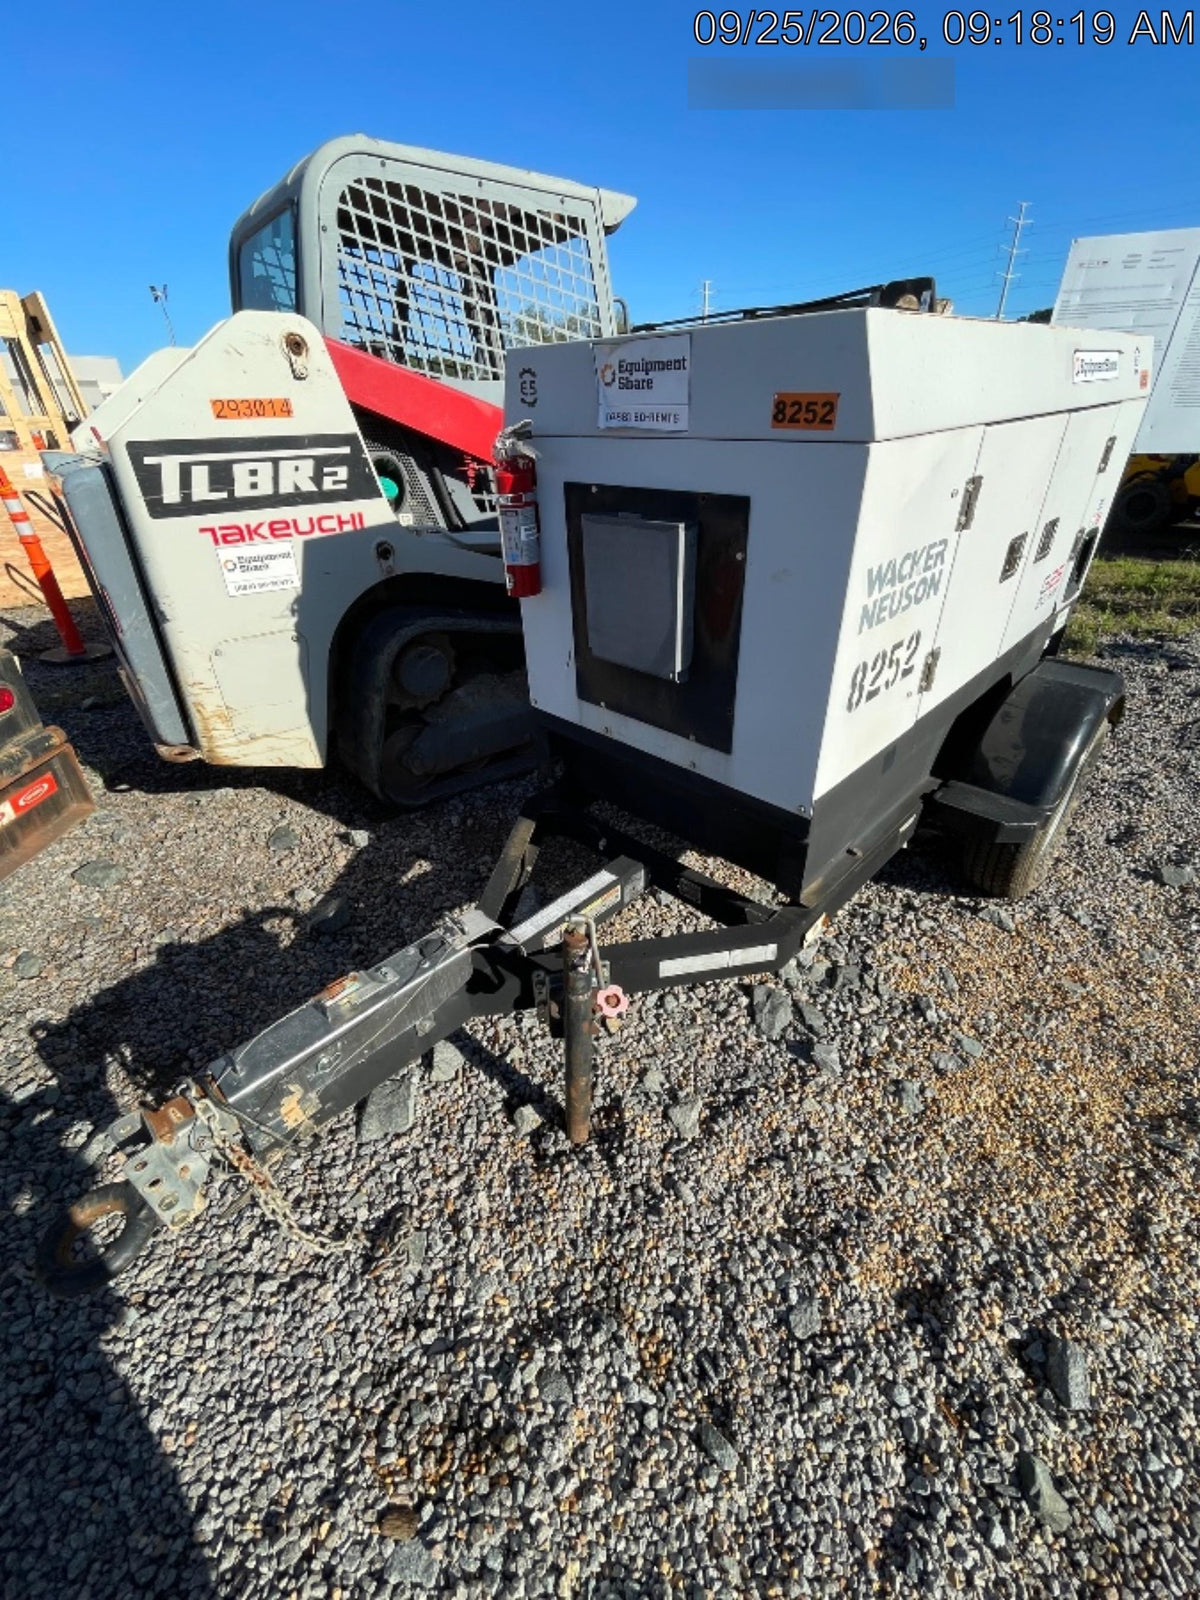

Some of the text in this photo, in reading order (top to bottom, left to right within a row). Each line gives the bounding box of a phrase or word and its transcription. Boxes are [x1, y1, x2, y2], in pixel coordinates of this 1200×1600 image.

[618, 356, 687, 376] Equipment
[618, 376, 653, 391] Share
[212, 398, 293, 418] 293014
[773, 400, 834, 424] 8252
[867, 538, 948, 598] WACKER
[858, 568, 943, 635] NEUSON
[846, 629, 921, 713] 8252
